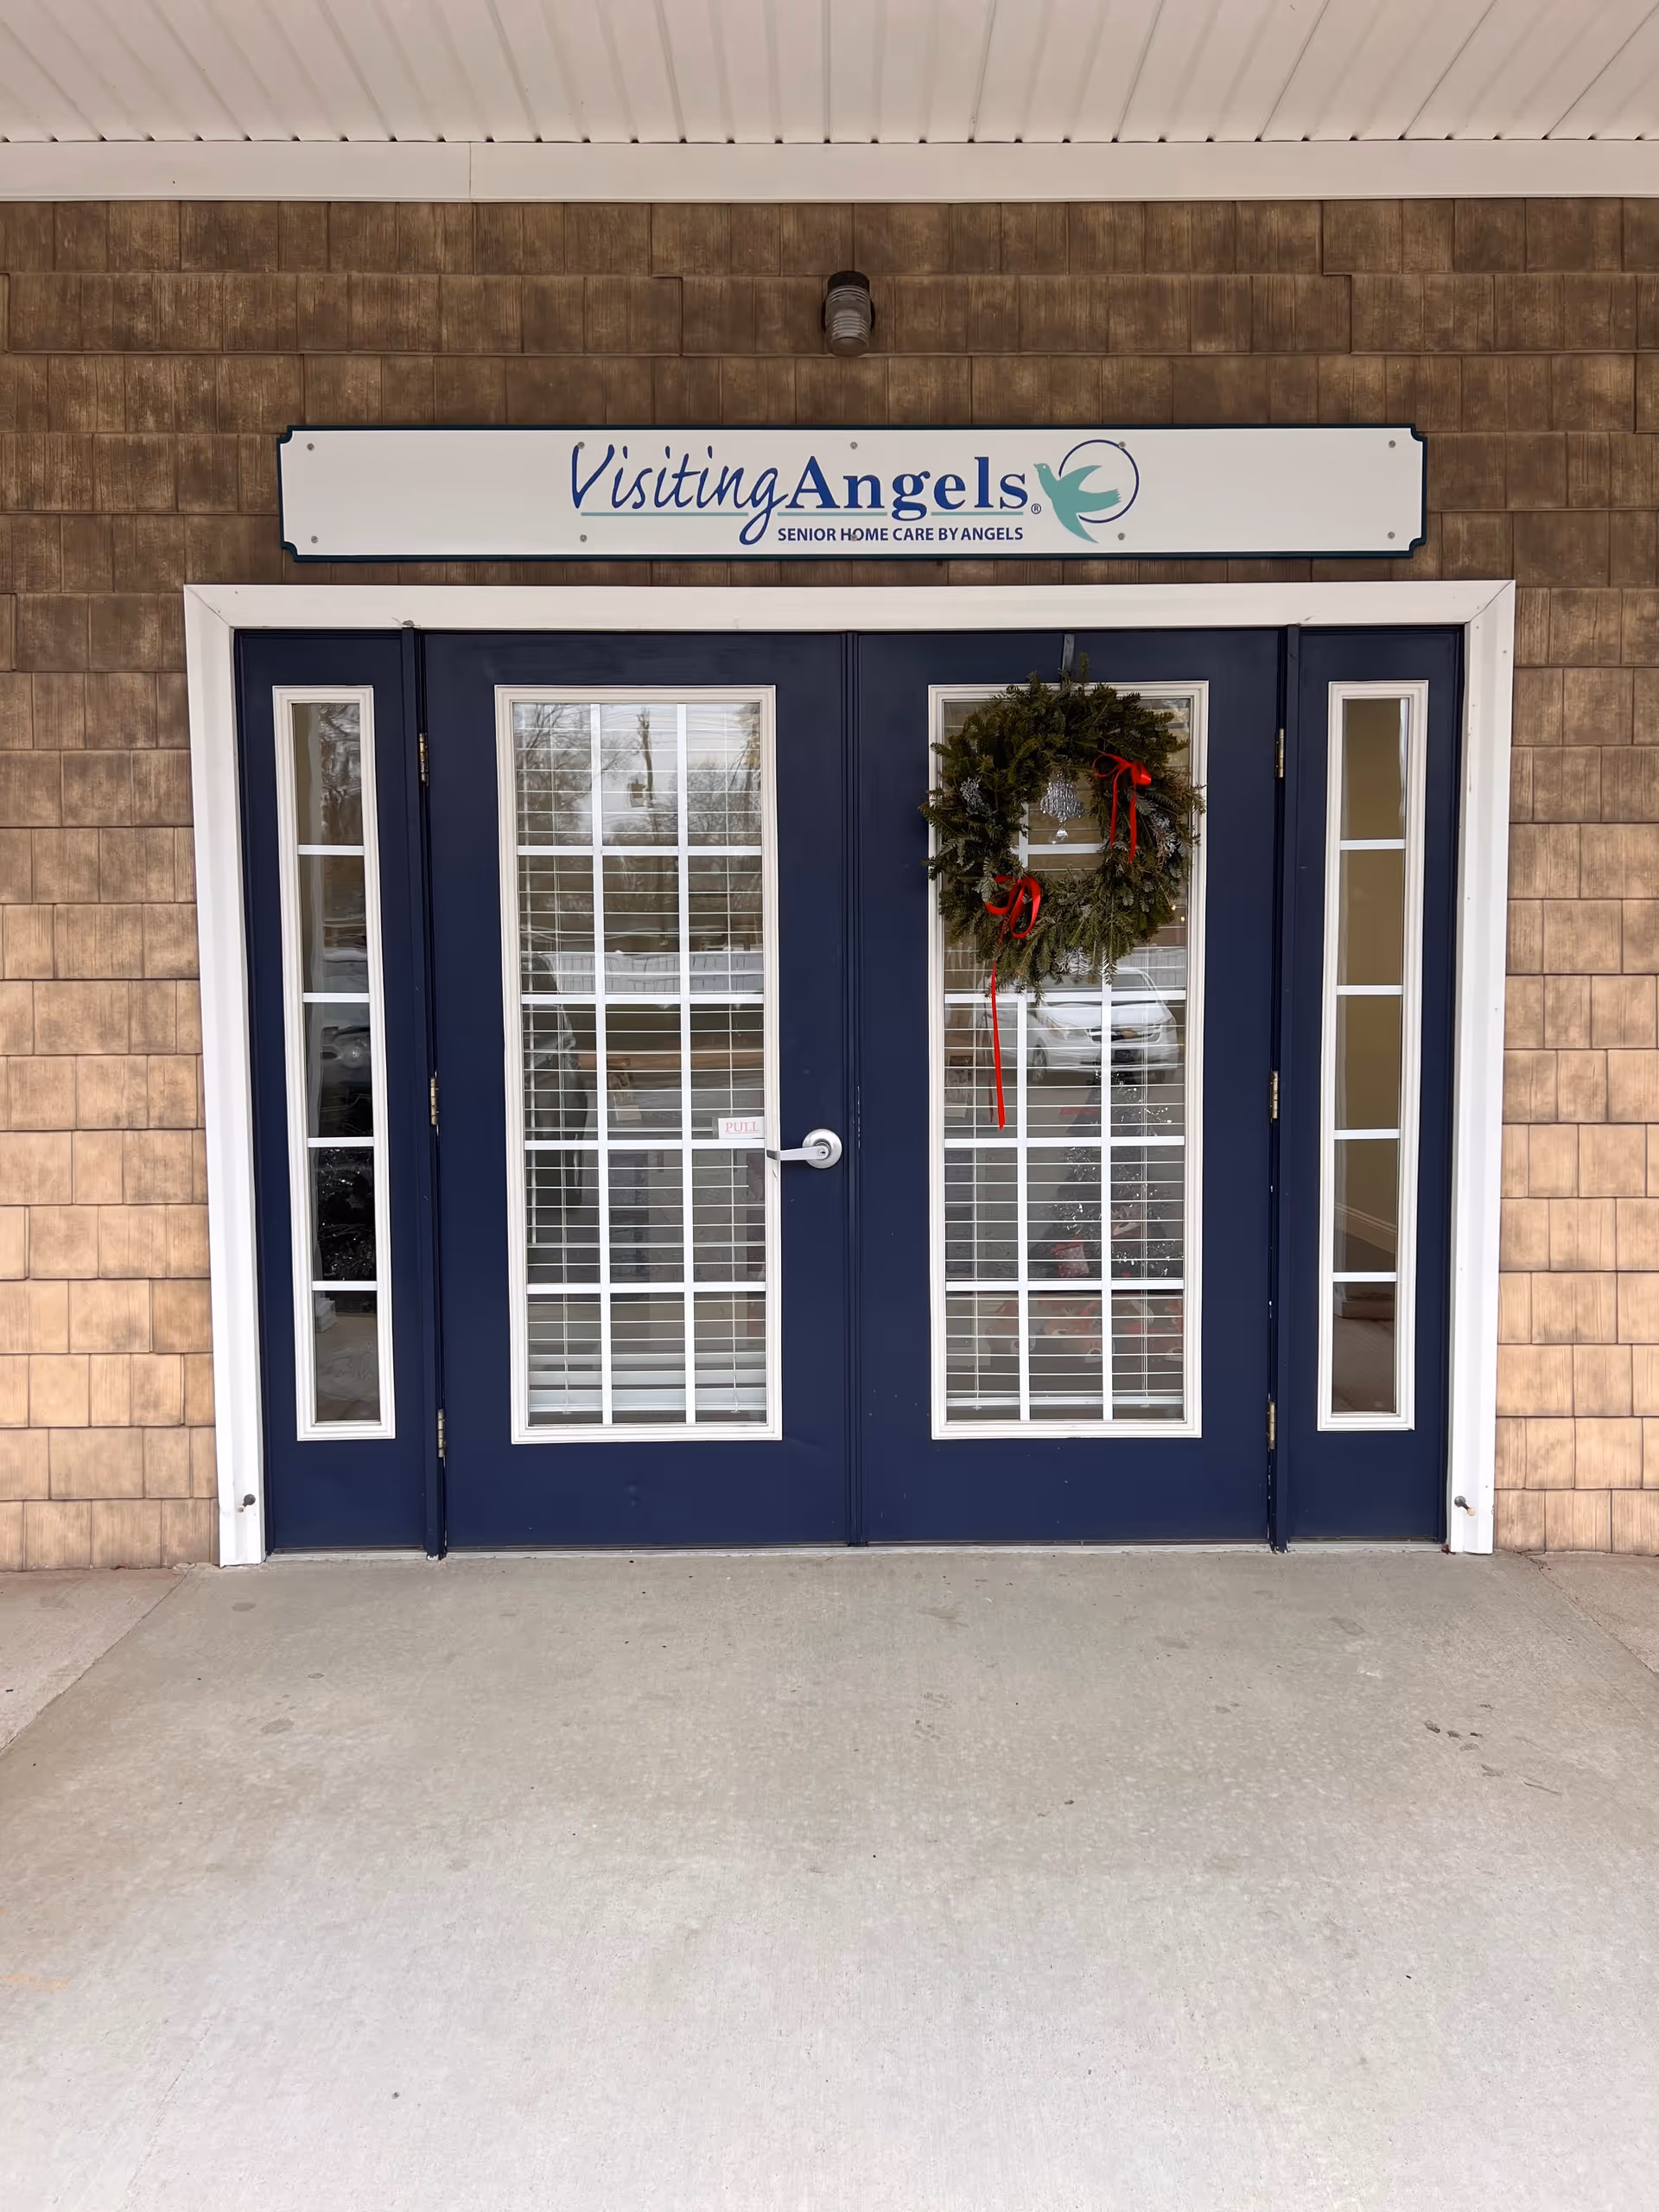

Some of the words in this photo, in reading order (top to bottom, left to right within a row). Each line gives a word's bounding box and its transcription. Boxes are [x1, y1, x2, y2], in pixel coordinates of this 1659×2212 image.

[572, 442, 789, 545] Visiting
[779, 528, 836, 542] SENIOR
[842, 528, 889, 542] HOME
[893, 527, 934, 541] CARE
[939, 527, 959, 541] BY
[961, 527, 1023, 541] ANGELS
[725, 1122, 760, 1133] PULL
